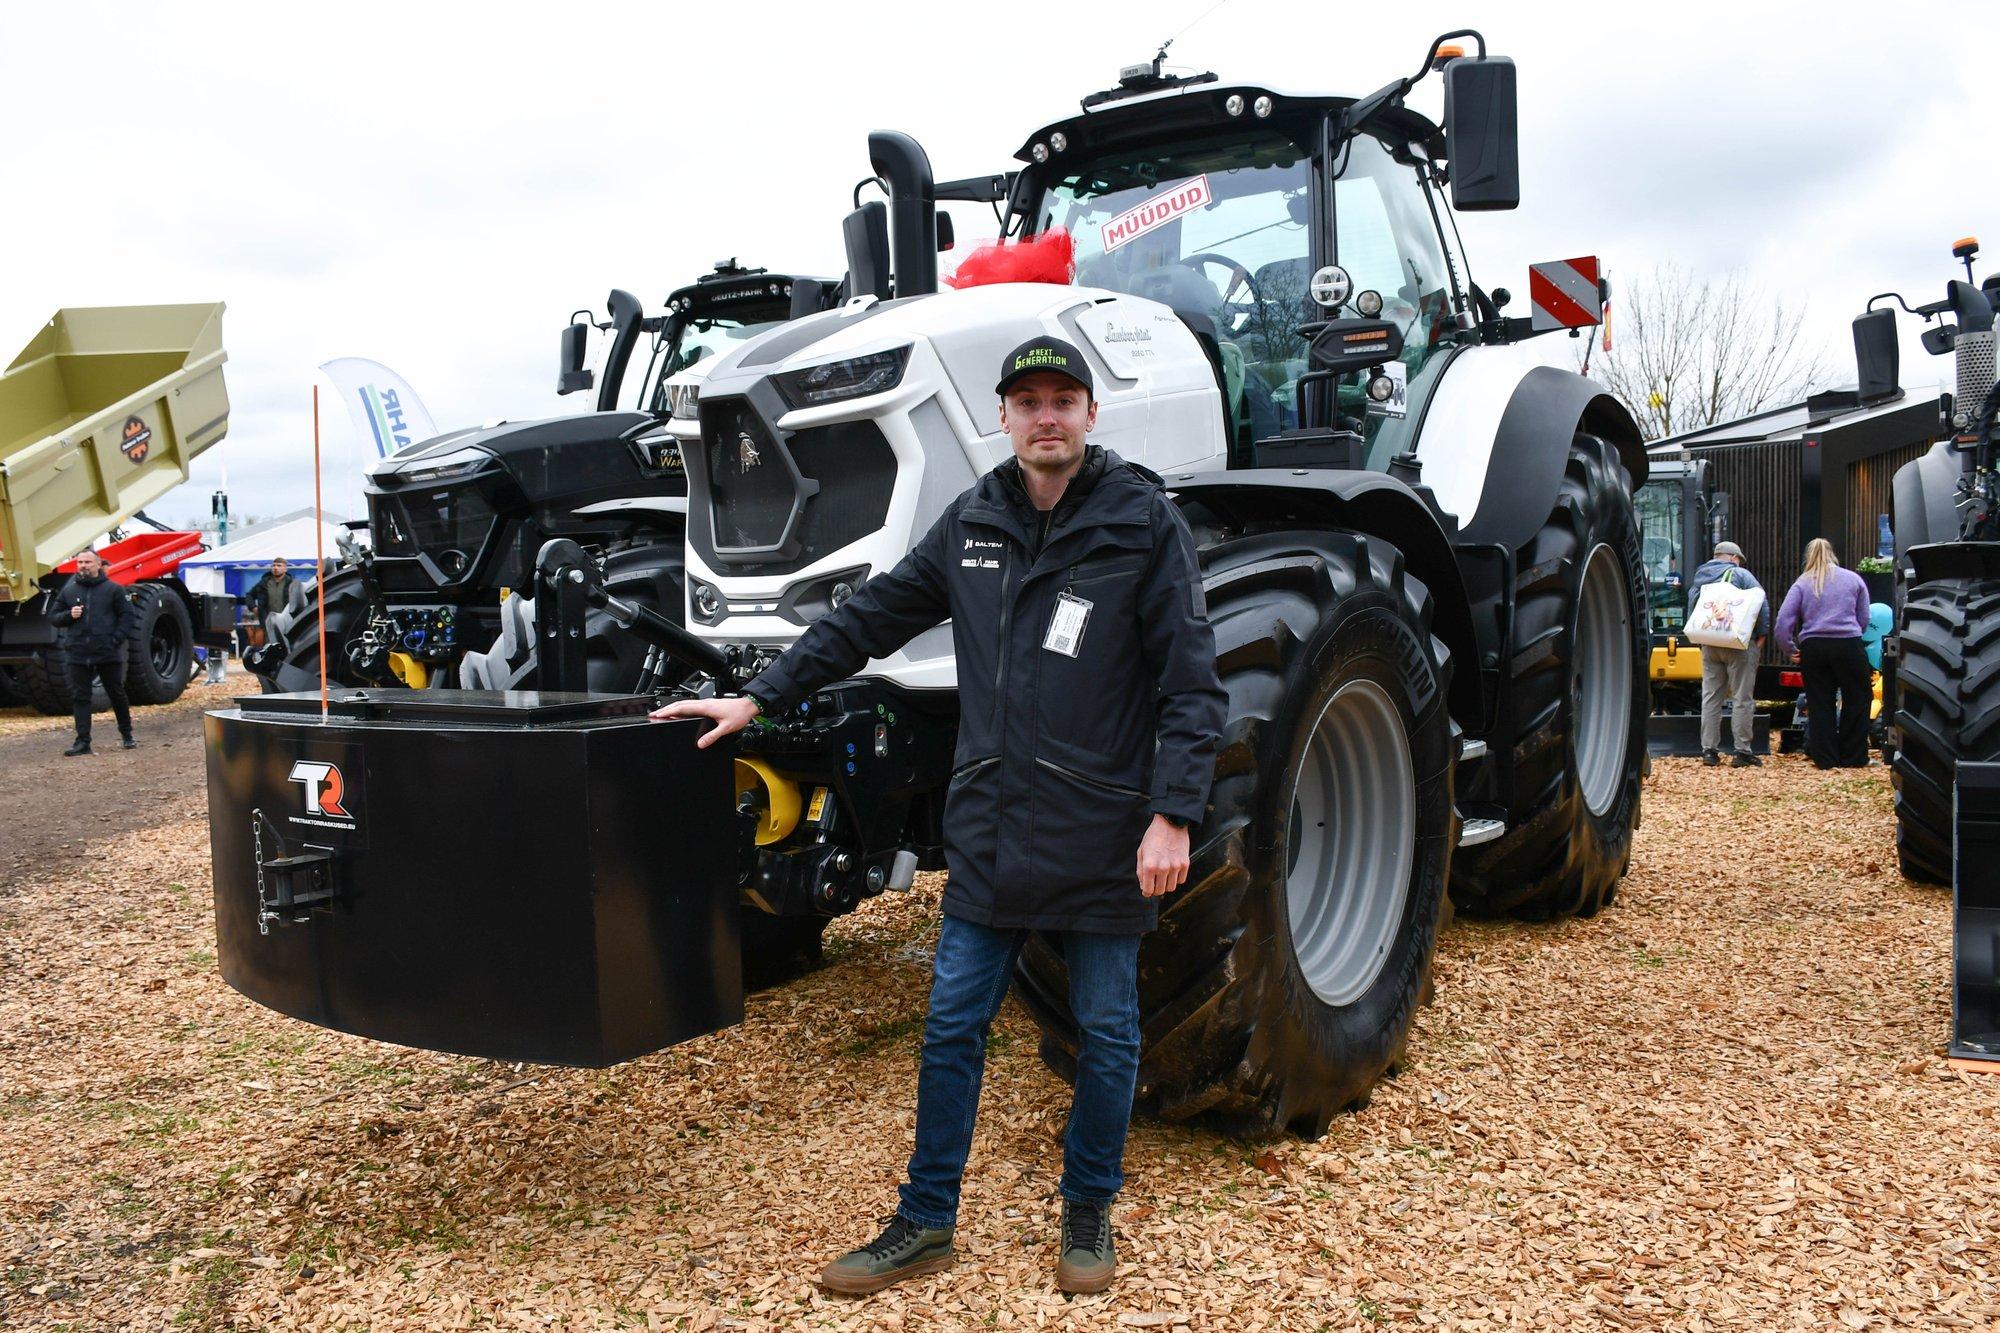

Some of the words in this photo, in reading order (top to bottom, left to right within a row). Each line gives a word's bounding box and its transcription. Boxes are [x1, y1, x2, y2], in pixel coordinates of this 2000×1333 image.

[1108, 187, 1202, 244] MÜÜDUD
[711, 289, 763, 301] DEUTZ-FAHR
[660, 448, 681, 456] 934
[661, 456, 683, 467] WAR
